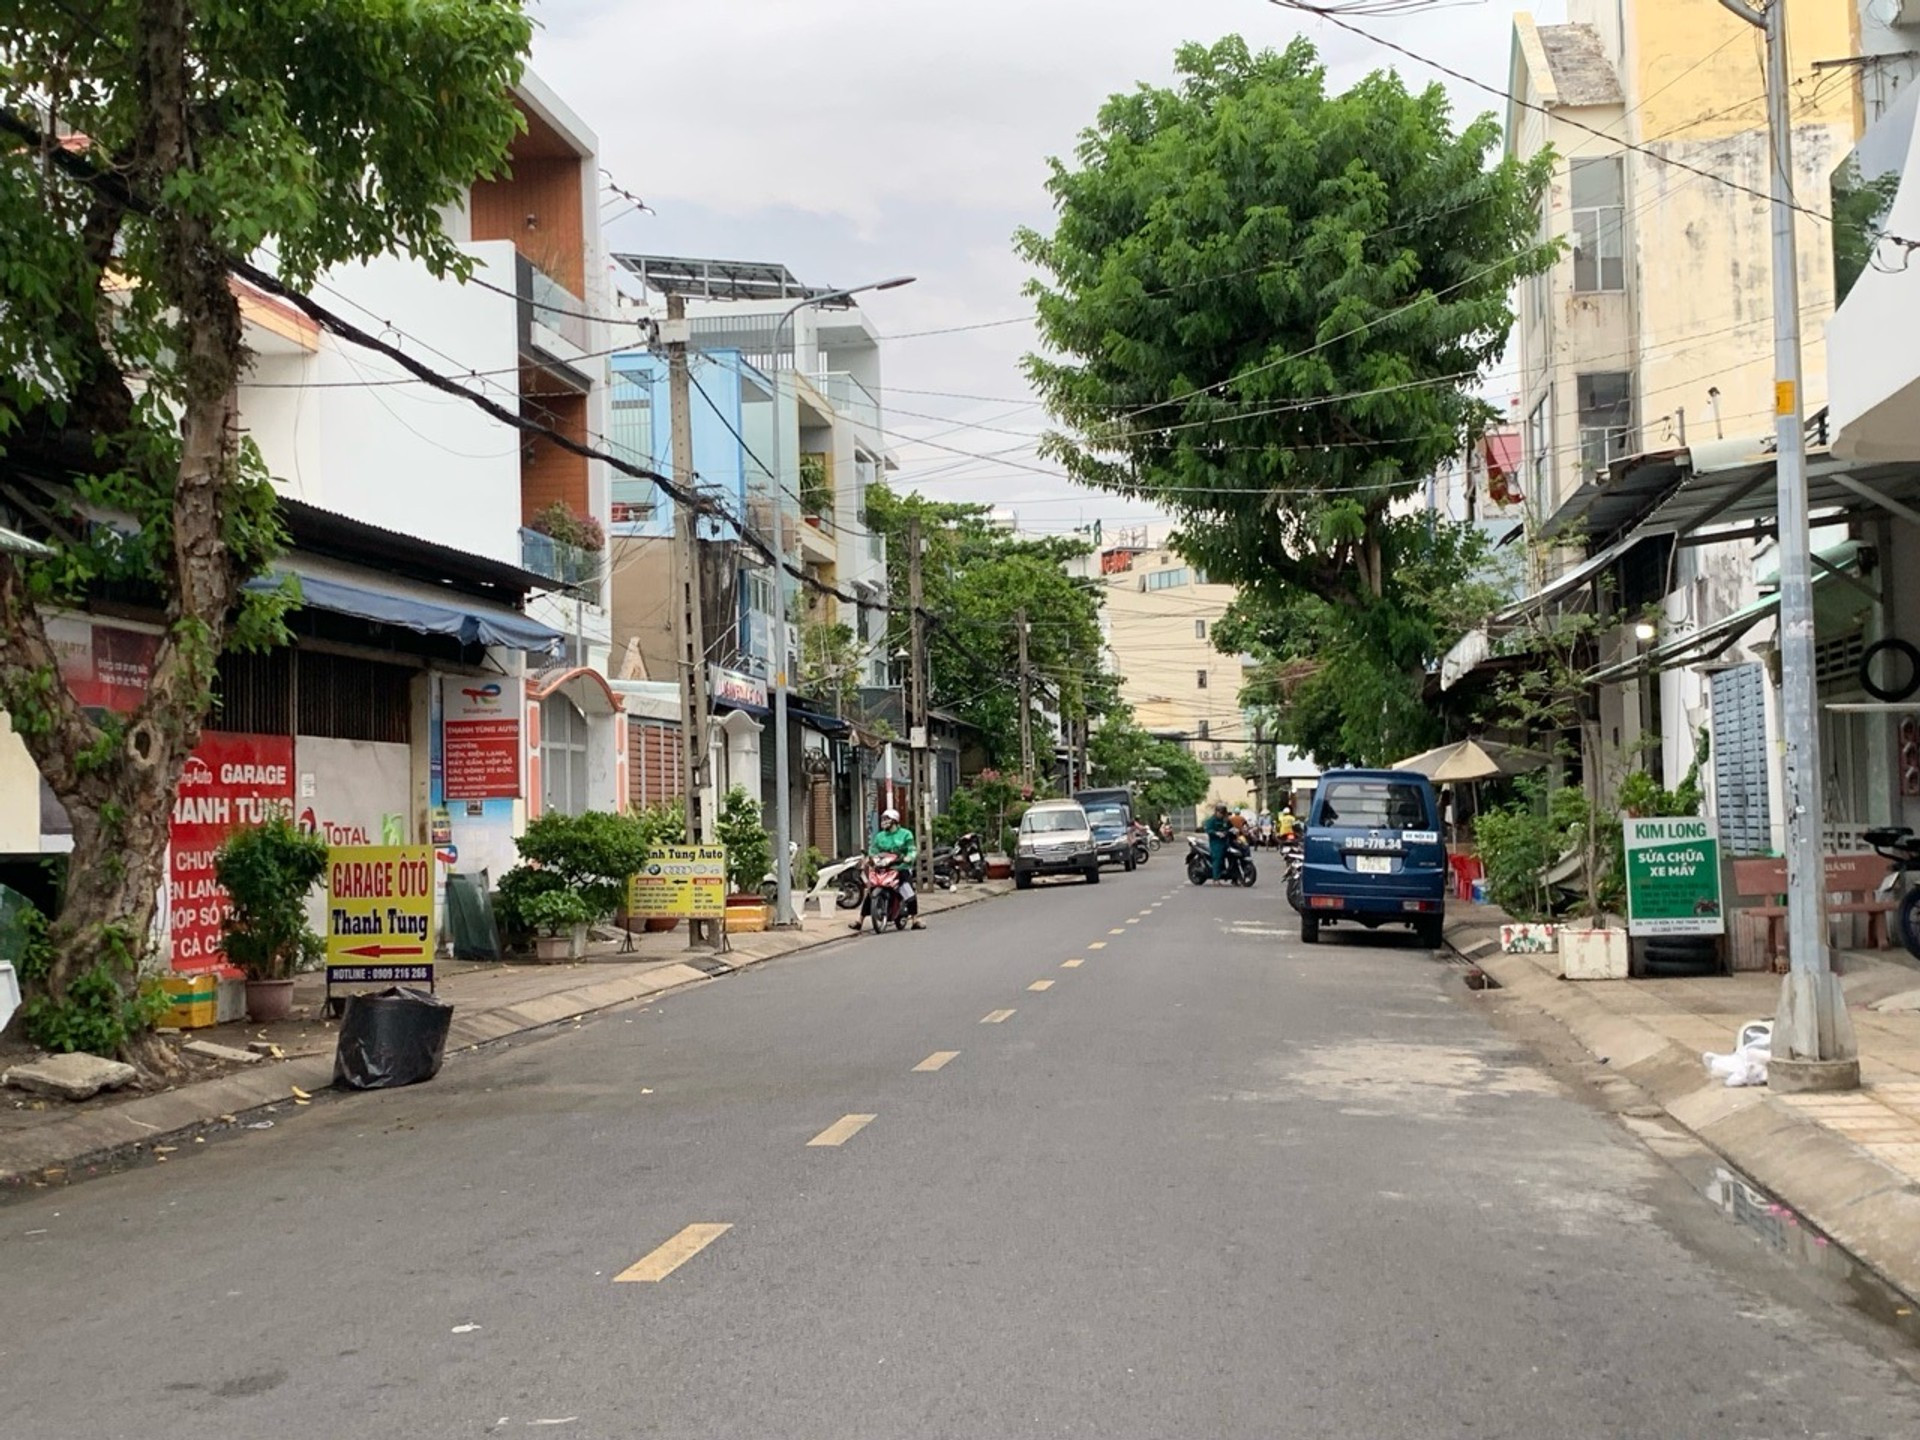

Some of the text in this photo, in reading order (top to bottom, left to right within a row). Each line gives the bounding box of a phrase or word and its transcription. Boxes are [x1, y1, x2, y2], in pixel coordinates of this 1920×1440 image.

[447, 725, 474, 734] THANH
[497, 723, 519, 733] AUTO
[220, 763, 287, 785] GARAGE
[235, 790, 294, 824] TÙNG
[1635, 822, 1707, 839] KIM LONG
[175, 849, 219, 871] CHUY
[698, 847, 723, 859] Auto
[1638, 848, 1706, 864] SỬA CHỮA
[332, 852, 429, 898] GARAGE ÔTÔ
[1649, 862, 1697, 878] XE MÁY
[199, 900, 220, 926] SỐ
[332, 907, 429, 942] Thanh Tùng
[180, 931, 202, 958] CẢ
[332, 967, 366, 980] HOTLINE
[372, 967, 393, 979] 0909
